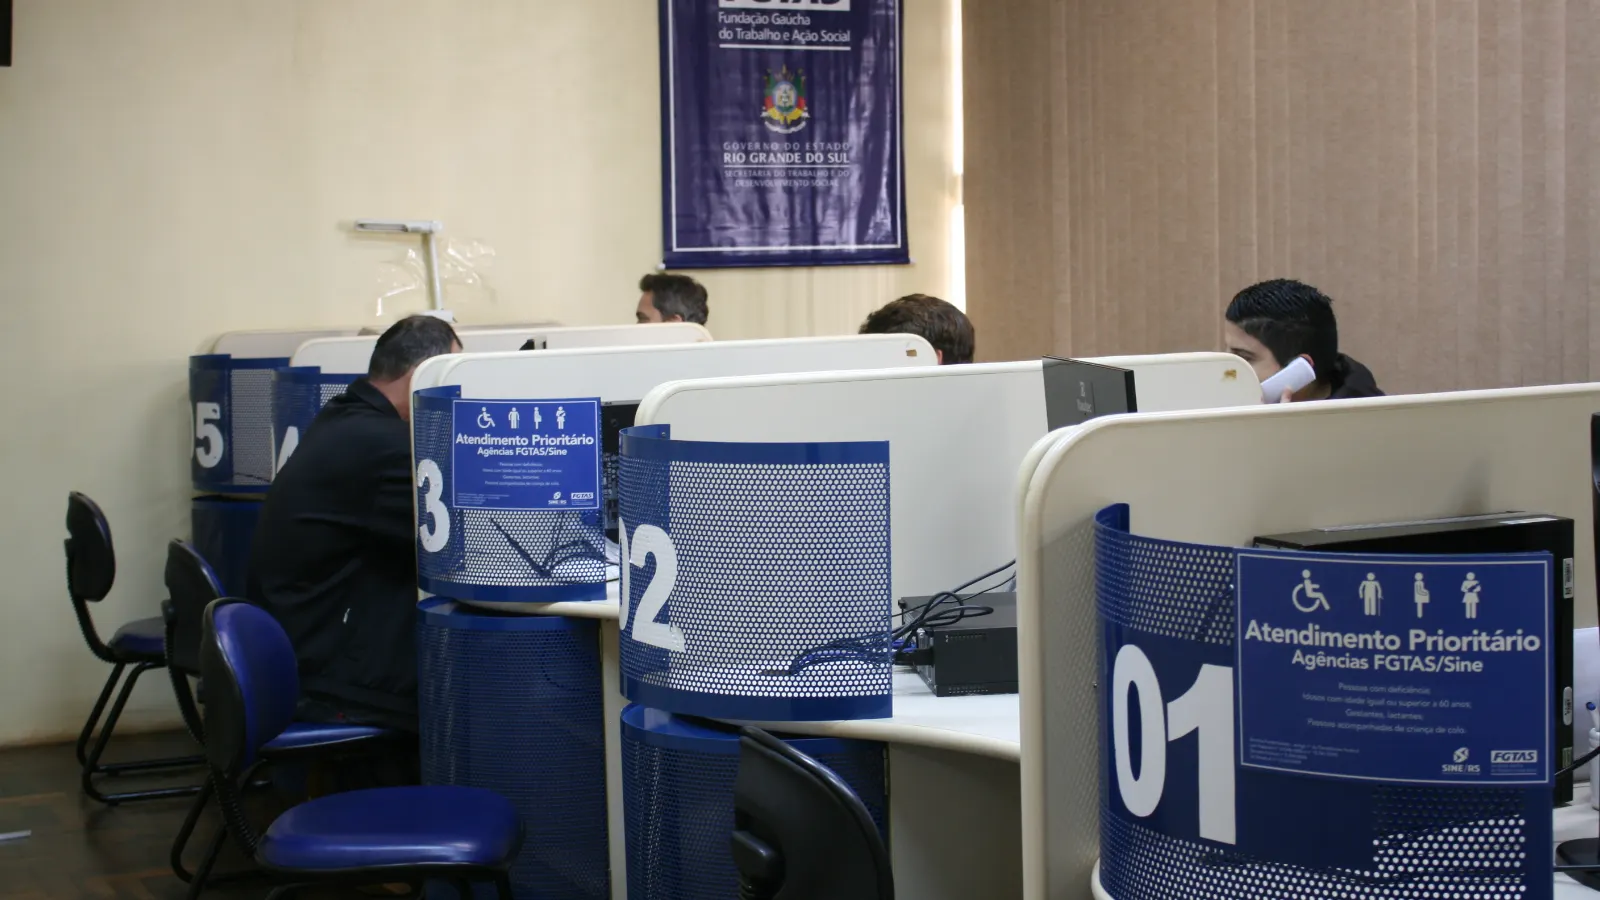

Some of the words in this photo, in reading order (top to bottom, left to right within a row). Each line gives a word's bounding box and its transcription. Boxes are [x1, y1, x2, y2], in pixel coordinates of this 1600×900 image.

[718, 11, 769, 26] Fundação
[771, 12, 811, 25] Gaúcha
[718, 27, 733, 40] do
[735, 28, 781, 41] Trabalho
[783, 31, 790, 40] e
[792, 29, 818, 44] Ação
[821, 30, 850, 42] Social
[723, 142, 779, 151] GOVERNO
[784, 142, 800, 151] DO
[806, 142, 850, 151] ESTADO
[723, 152, 746, 163] RIO
[749, 152, 801, 163] GRANDE
[805, 152, 824, 163] DO
[827, 152, 850, 163] SUL
[455, 433, 529, 446] Atendimento
[531, 434, 594, 446] Prioritário
[477, 447, 514, 457] Agências
[515, 447, 567, 456] FGTAS/Sine
[1244, 619, 1401, 651] Atendimento
[1408, 629, 1541, 652] Prioritário
[1292, 649, 1369, 670] Agências
[1373, 655, 1484, 673] FGTAS/Sine
[1338, 682, 1368, 692] Pessoas
[1398, 699, 1430, 708] superior
[1439, 699, 1450, 708] 60
[1307, 718, 1336, 728] Pessoas
[1394, 724, 1405, 732] de
[1435, 726, 1446, 734] de
[1112, 643, 1236, 846] 01
[1493, 751, 1536, 762] FGTAS
